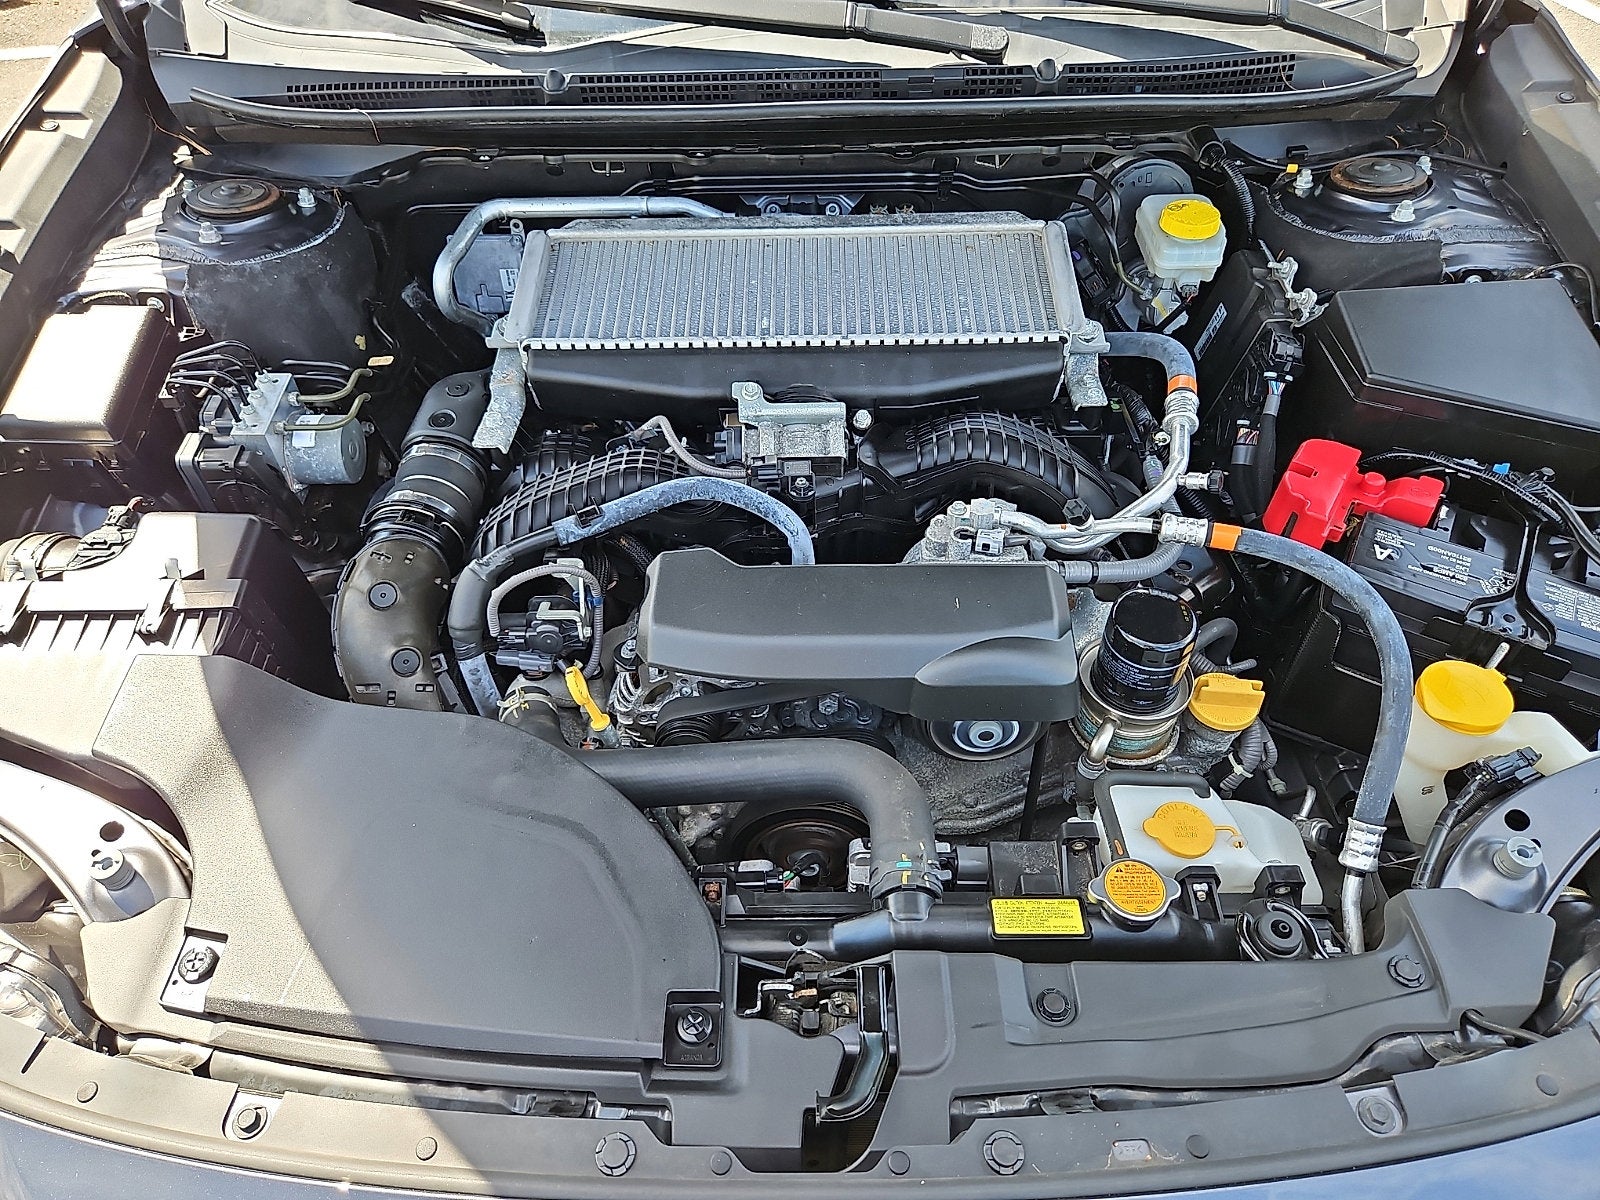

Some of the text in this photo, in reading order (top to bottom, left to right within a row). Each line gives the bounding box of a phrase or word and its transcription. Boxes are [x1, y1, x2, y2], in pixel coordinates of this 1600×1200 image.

[1407, 564, 1422, 573] AMPS
[1433, 565, 1454, 577] AMPS
[1423, 569, 1451, 581] CRANKING
[1451, 578, 1467, 586] COLD
